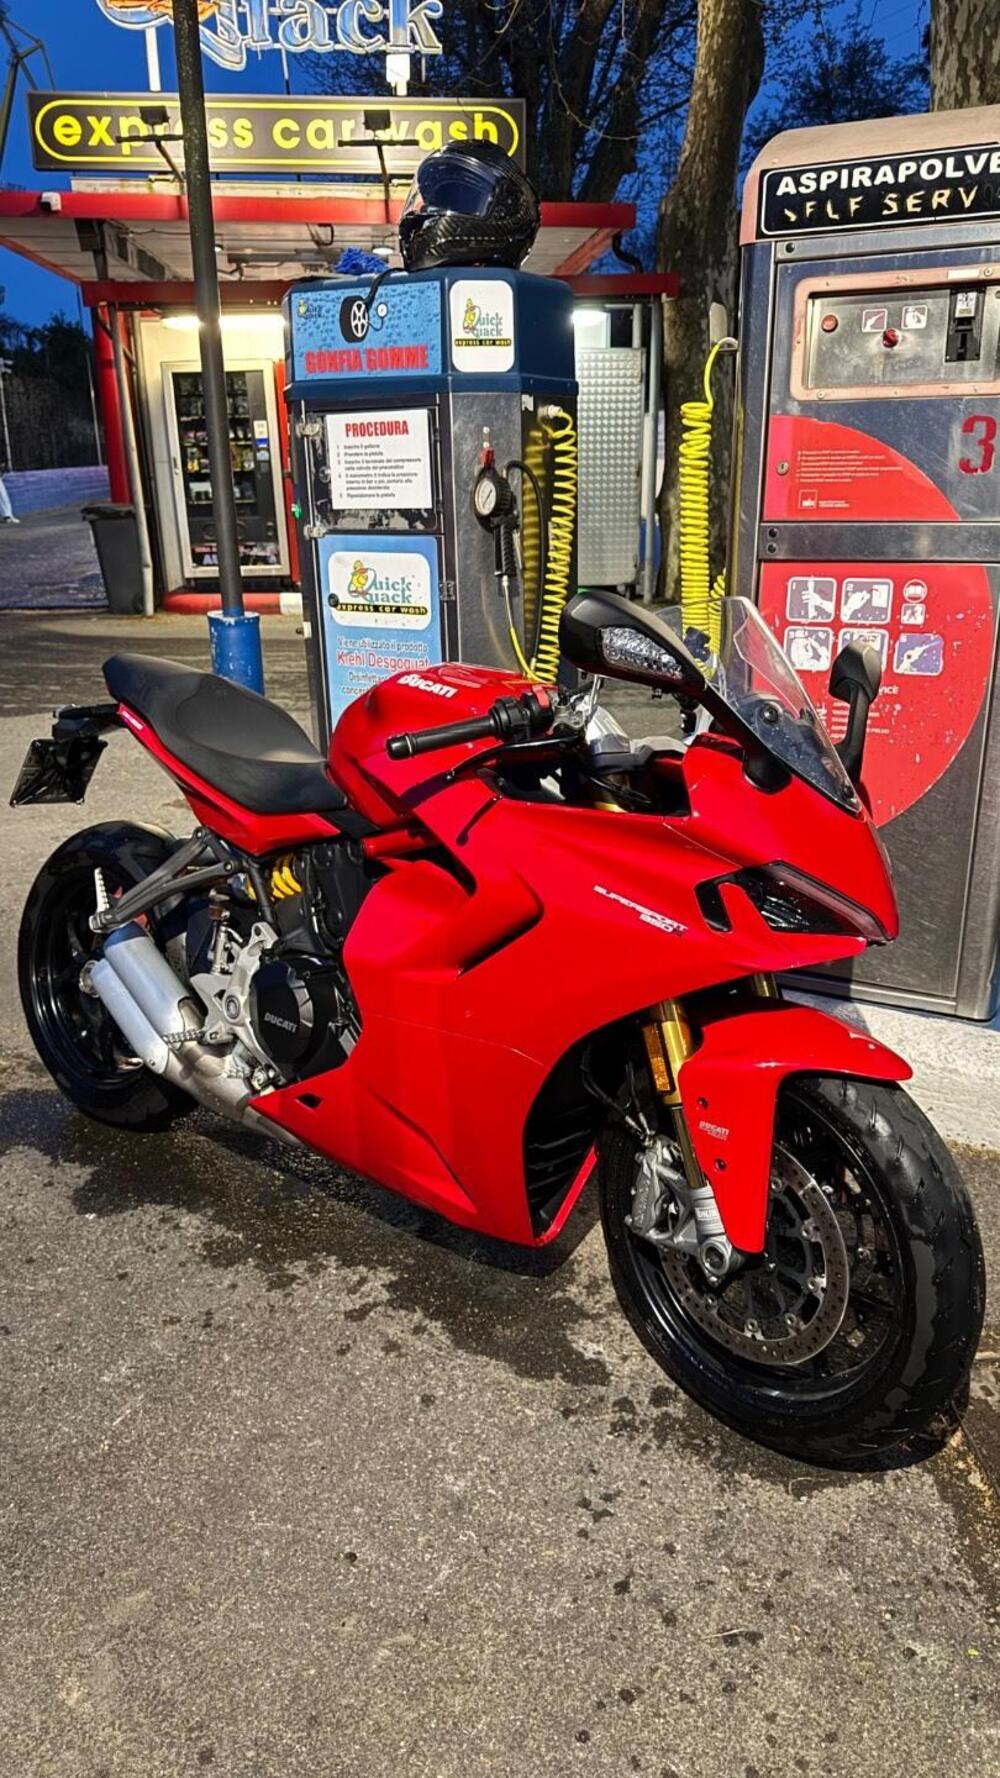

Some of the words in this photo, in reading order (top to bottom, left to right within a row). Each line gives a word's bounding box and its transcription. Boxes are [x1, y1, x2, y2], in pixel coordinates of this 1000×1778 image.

[272, 118, 355, 150] car
[305, 349, 362, 374] GONFIA
[365, 344, 429, 371] GOMME
[345, 420, 409, 437] PROCEDURA
[958, 414, 997, 474] 3
[348, 567, 412, 597] Quick
[379, 605, 396, 613] car
[400, 606, 426, 615] wash
[397, 674, 458, 698] DUCATI
[264, 1012, 297, 1032] DUCATI
